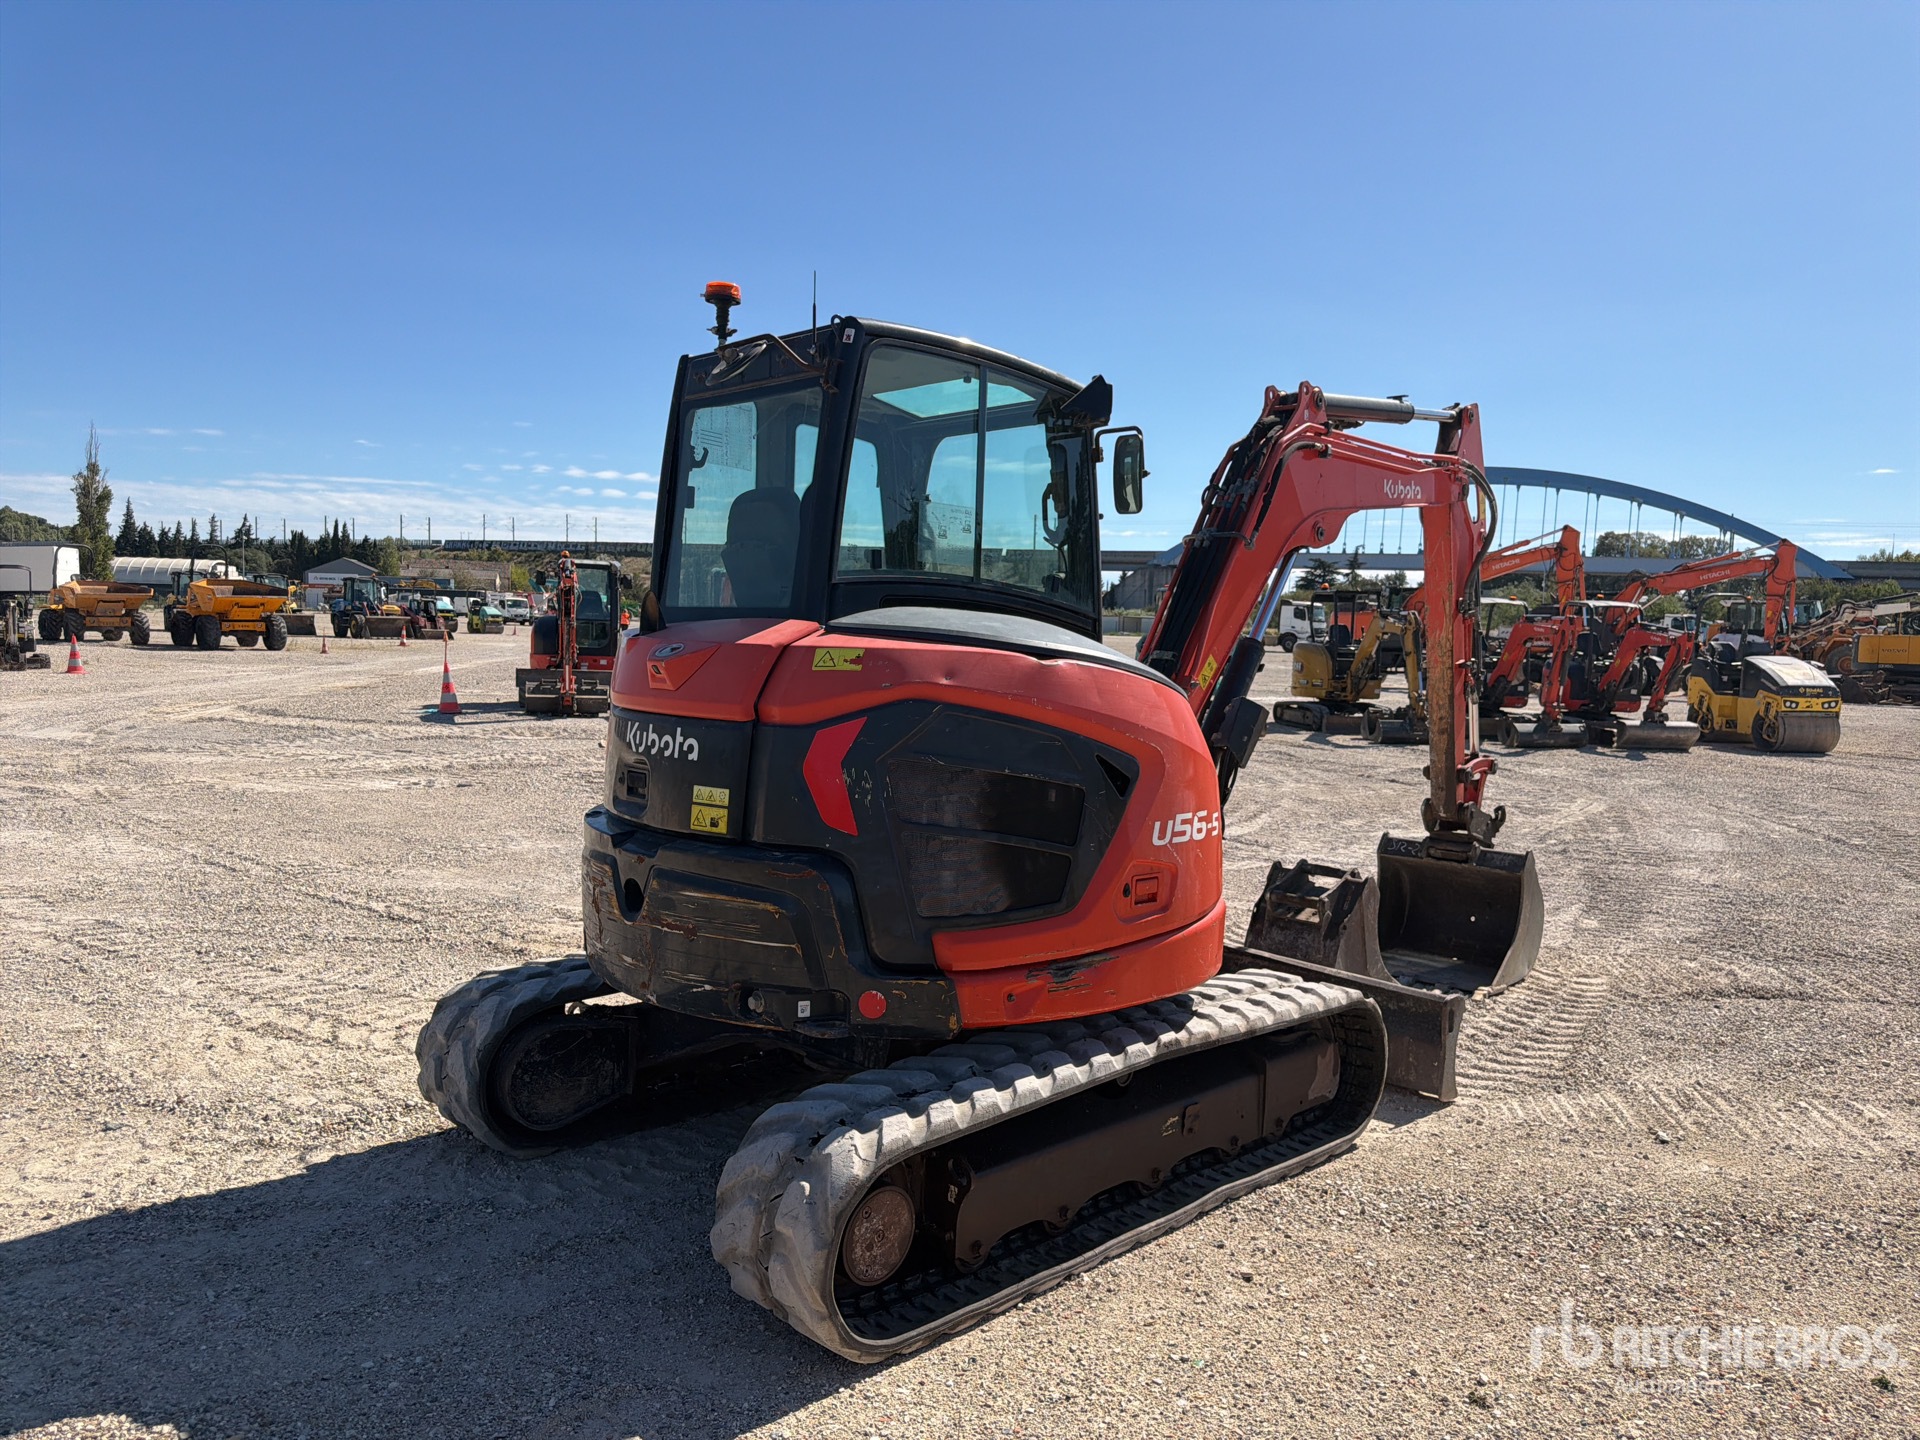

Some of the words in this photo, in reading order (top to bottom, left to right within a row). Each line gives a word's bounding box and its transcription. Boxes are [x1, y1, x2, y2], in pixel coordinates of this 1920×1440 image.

[1383, 479, 1422, 499] Kubota
[1491, 558, 1520, 571] HITACHI
[1700, 569, 1730, 581] HITACHI
[626, 721, 699, 761] Kubota
[1152, 809, 1219, 846] U56-5
